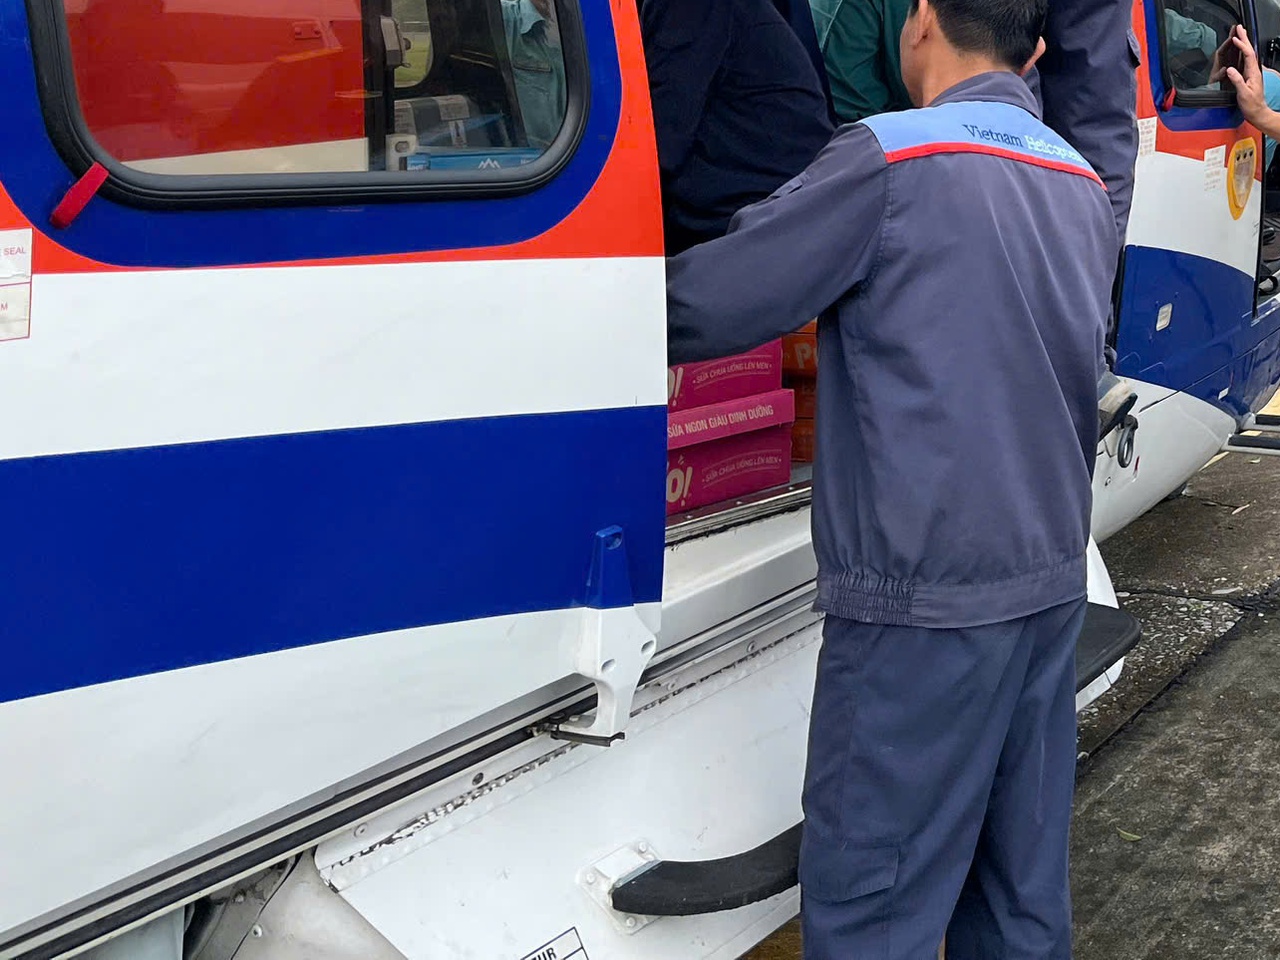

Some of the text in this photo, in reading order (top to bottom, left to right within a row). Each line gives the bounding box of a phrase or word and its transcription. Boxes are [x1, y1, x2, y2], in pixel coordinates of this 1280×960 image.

[962, 124, 1024, 148] Vietnam
[4, 247, 26, 255] SEAL
[685, 418, 708, 433] NGON
[709, 413, 728, 428] GIÀU
[729, 410, 747, 424] DINH
